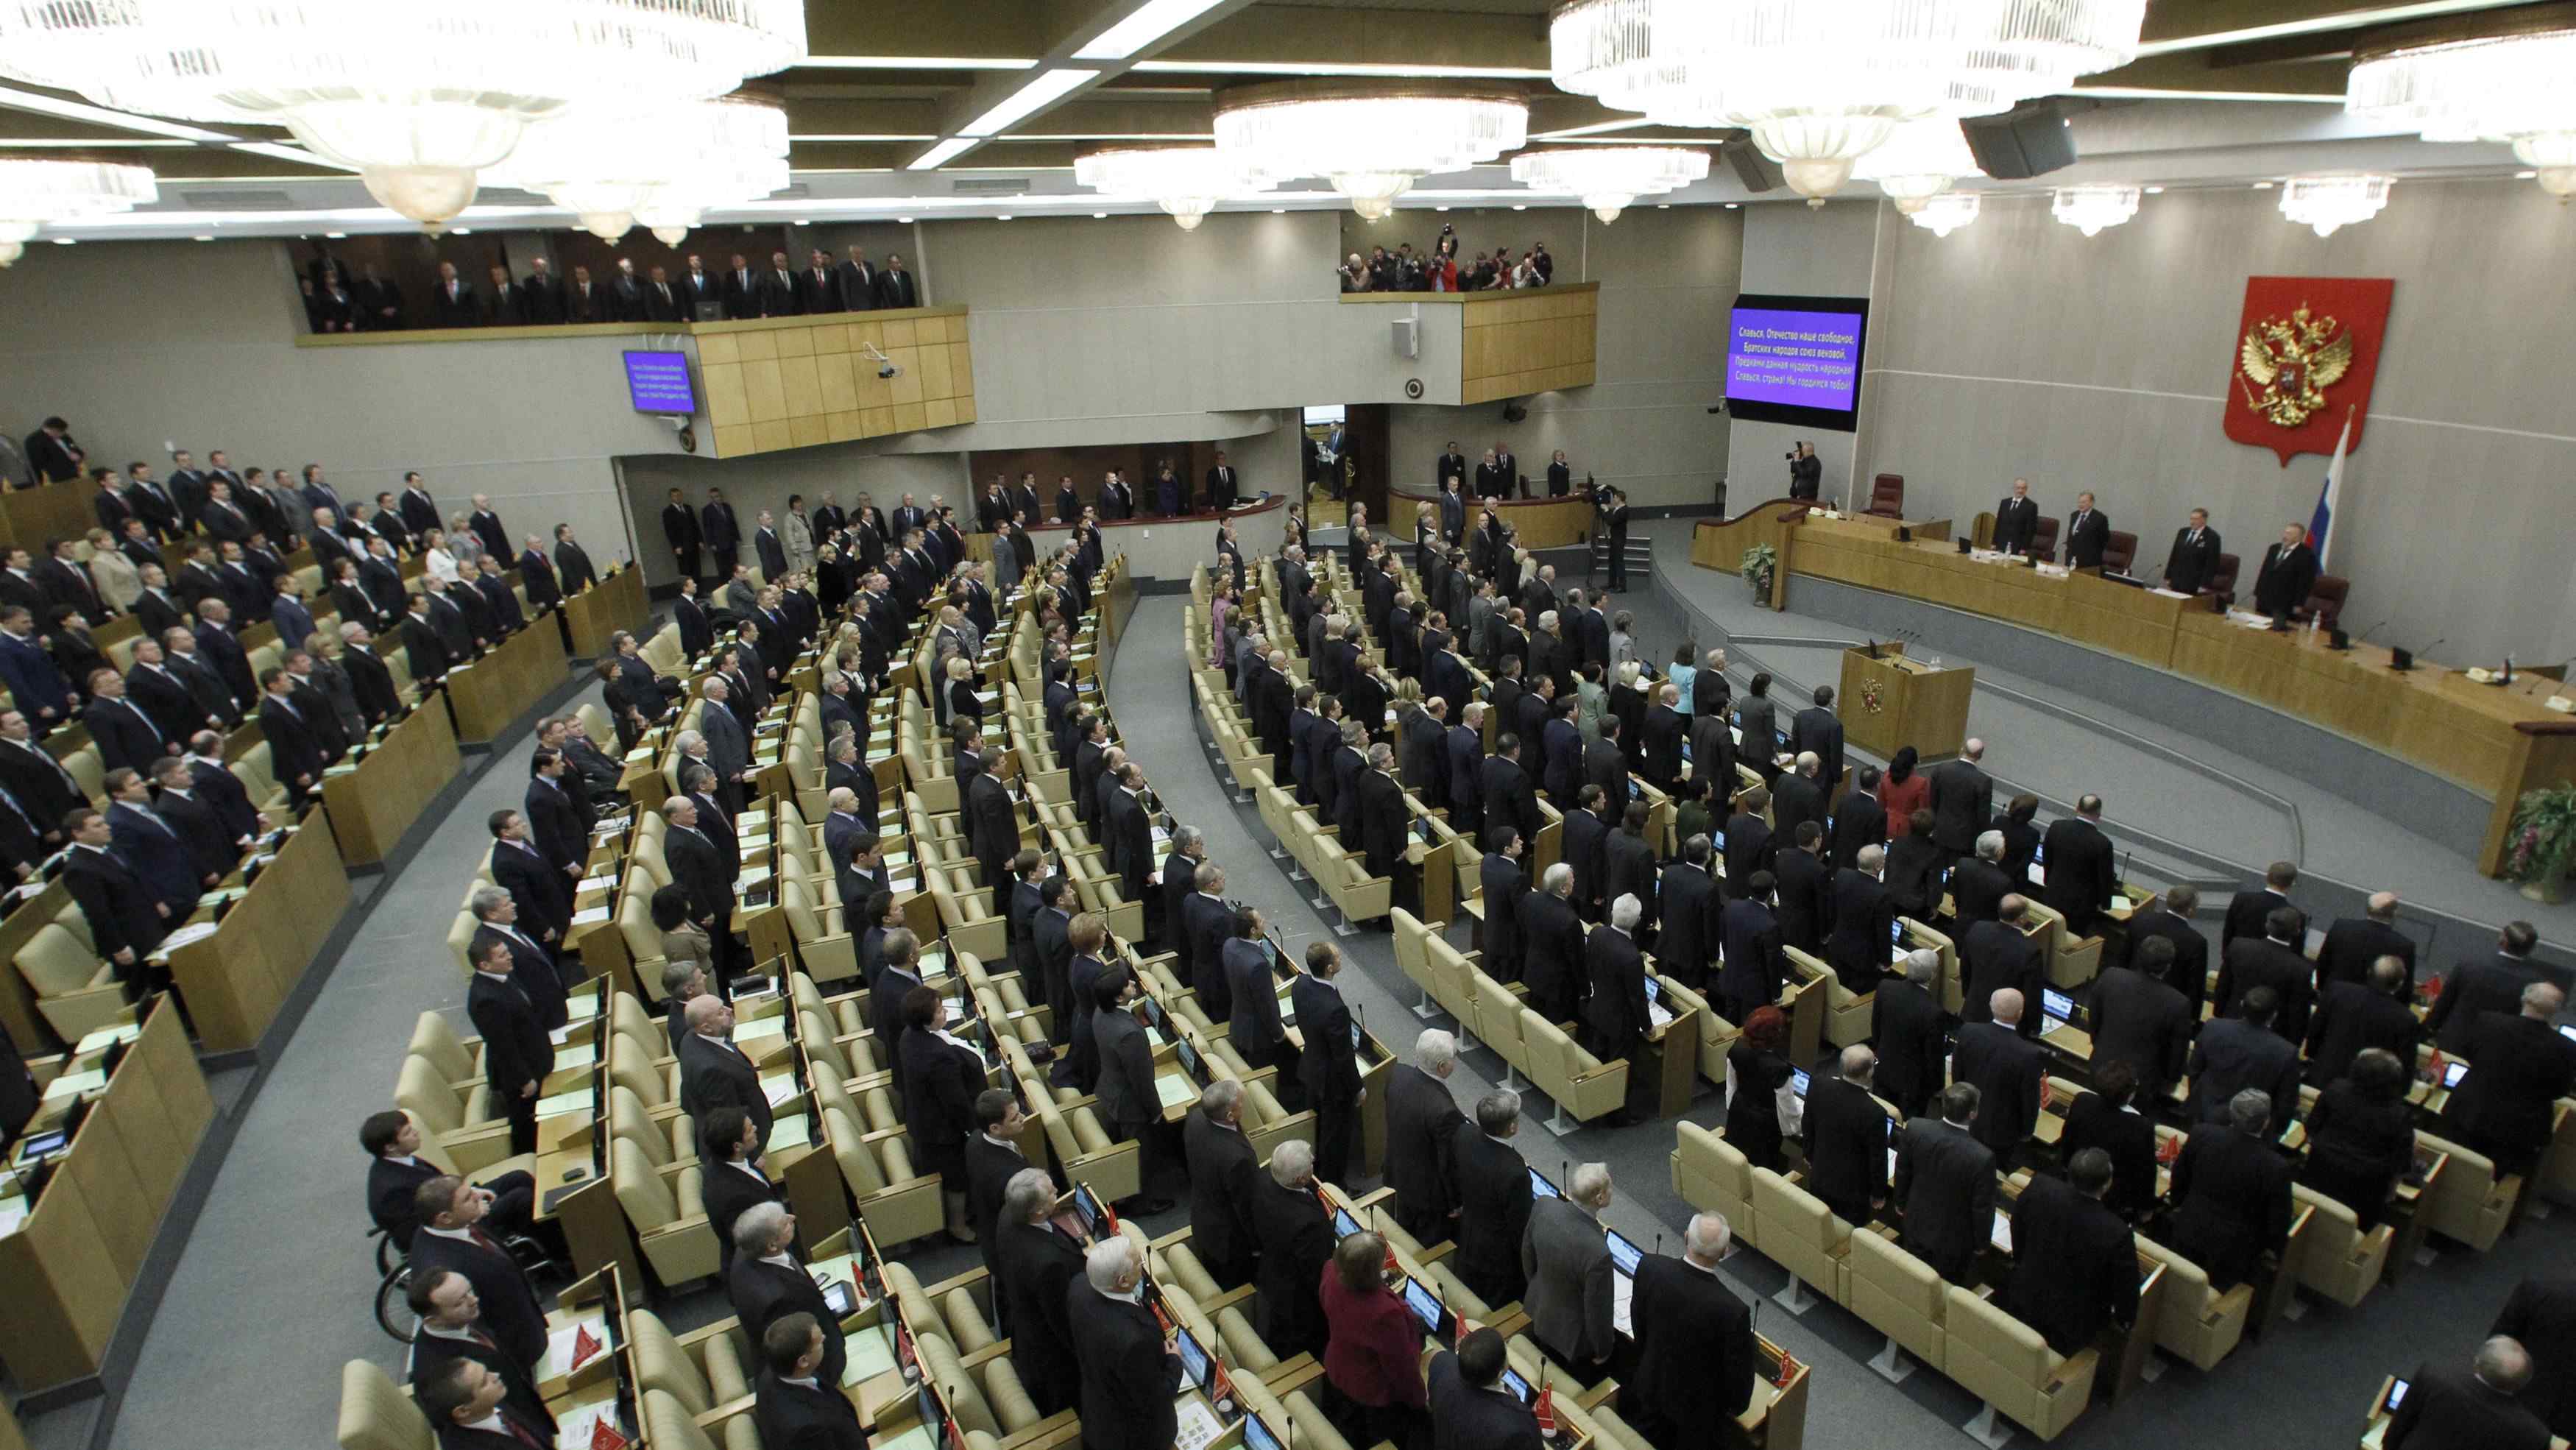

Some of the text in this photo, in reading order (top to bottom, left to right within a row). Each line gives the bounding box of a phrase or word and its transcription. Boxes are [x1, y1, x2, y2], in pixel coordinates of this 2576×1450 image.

[1766, 328, 1798, 340] Отечество
[1800, 332, 1816, 342] наше
[1744, 342, 1771, 353] Братских
[1772, 346, 1798, 356] народов
[1800, 348, 1816, 357] союз
